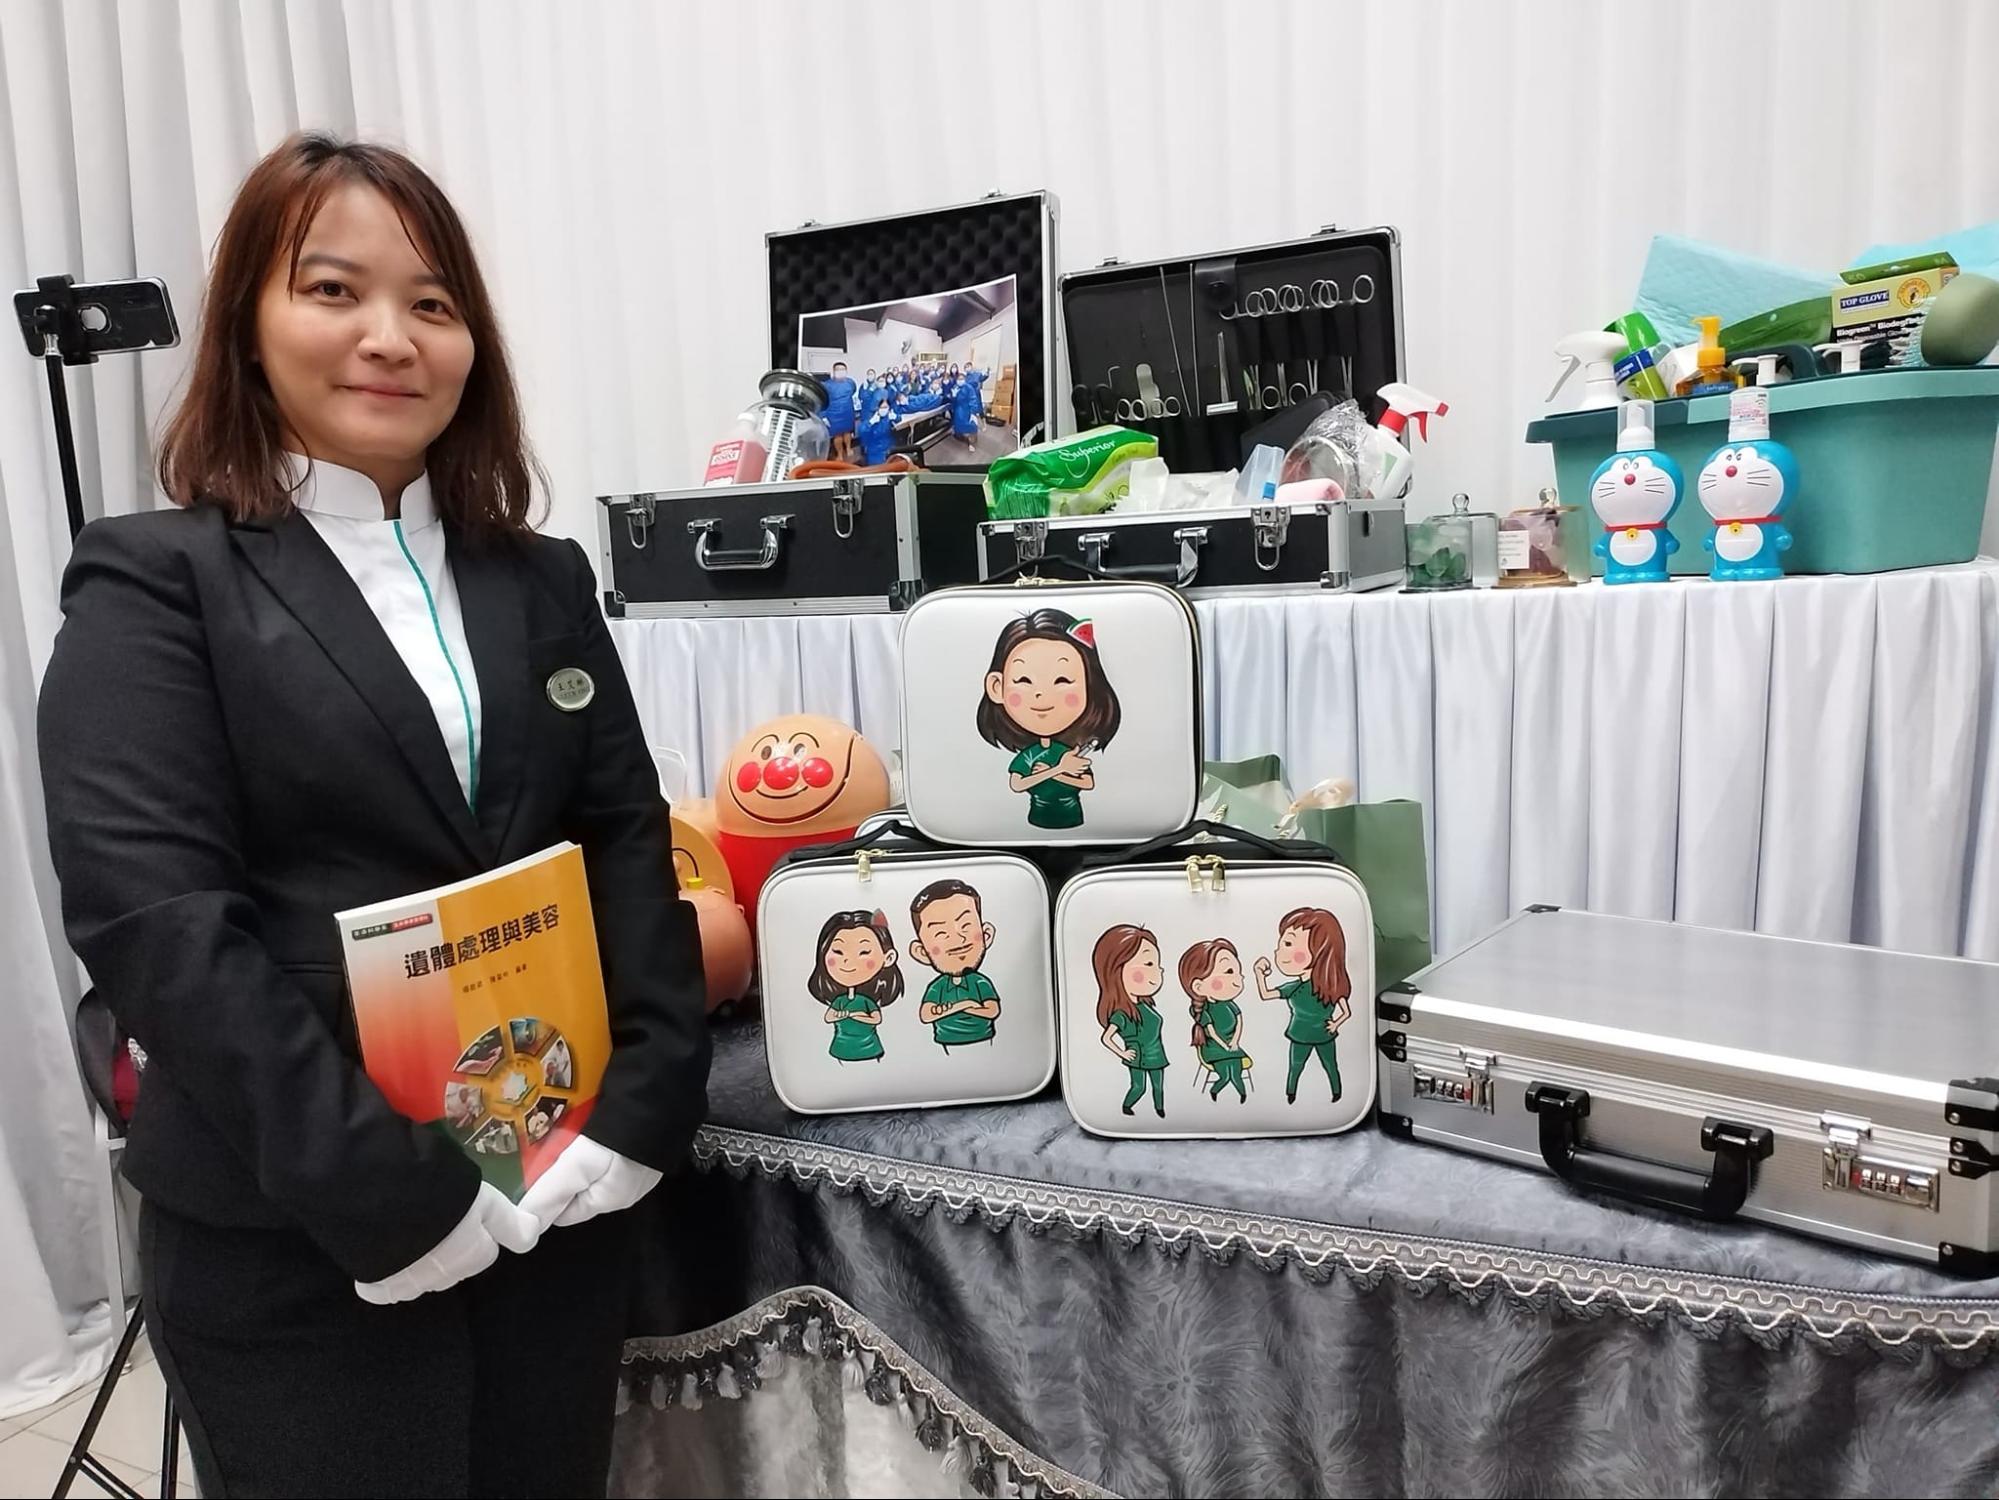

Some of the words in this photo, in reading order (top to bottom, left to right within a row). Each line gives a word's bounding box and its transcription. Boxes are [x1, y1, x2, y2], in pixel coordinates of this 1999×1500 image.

[1842, 299, 1858, 307] TOP
[1859, 292, 1888, 304] GLOVE
[1058, 441, 1116, 476] Superior
[404, 904, 559, 979] 遺體處理與美容
